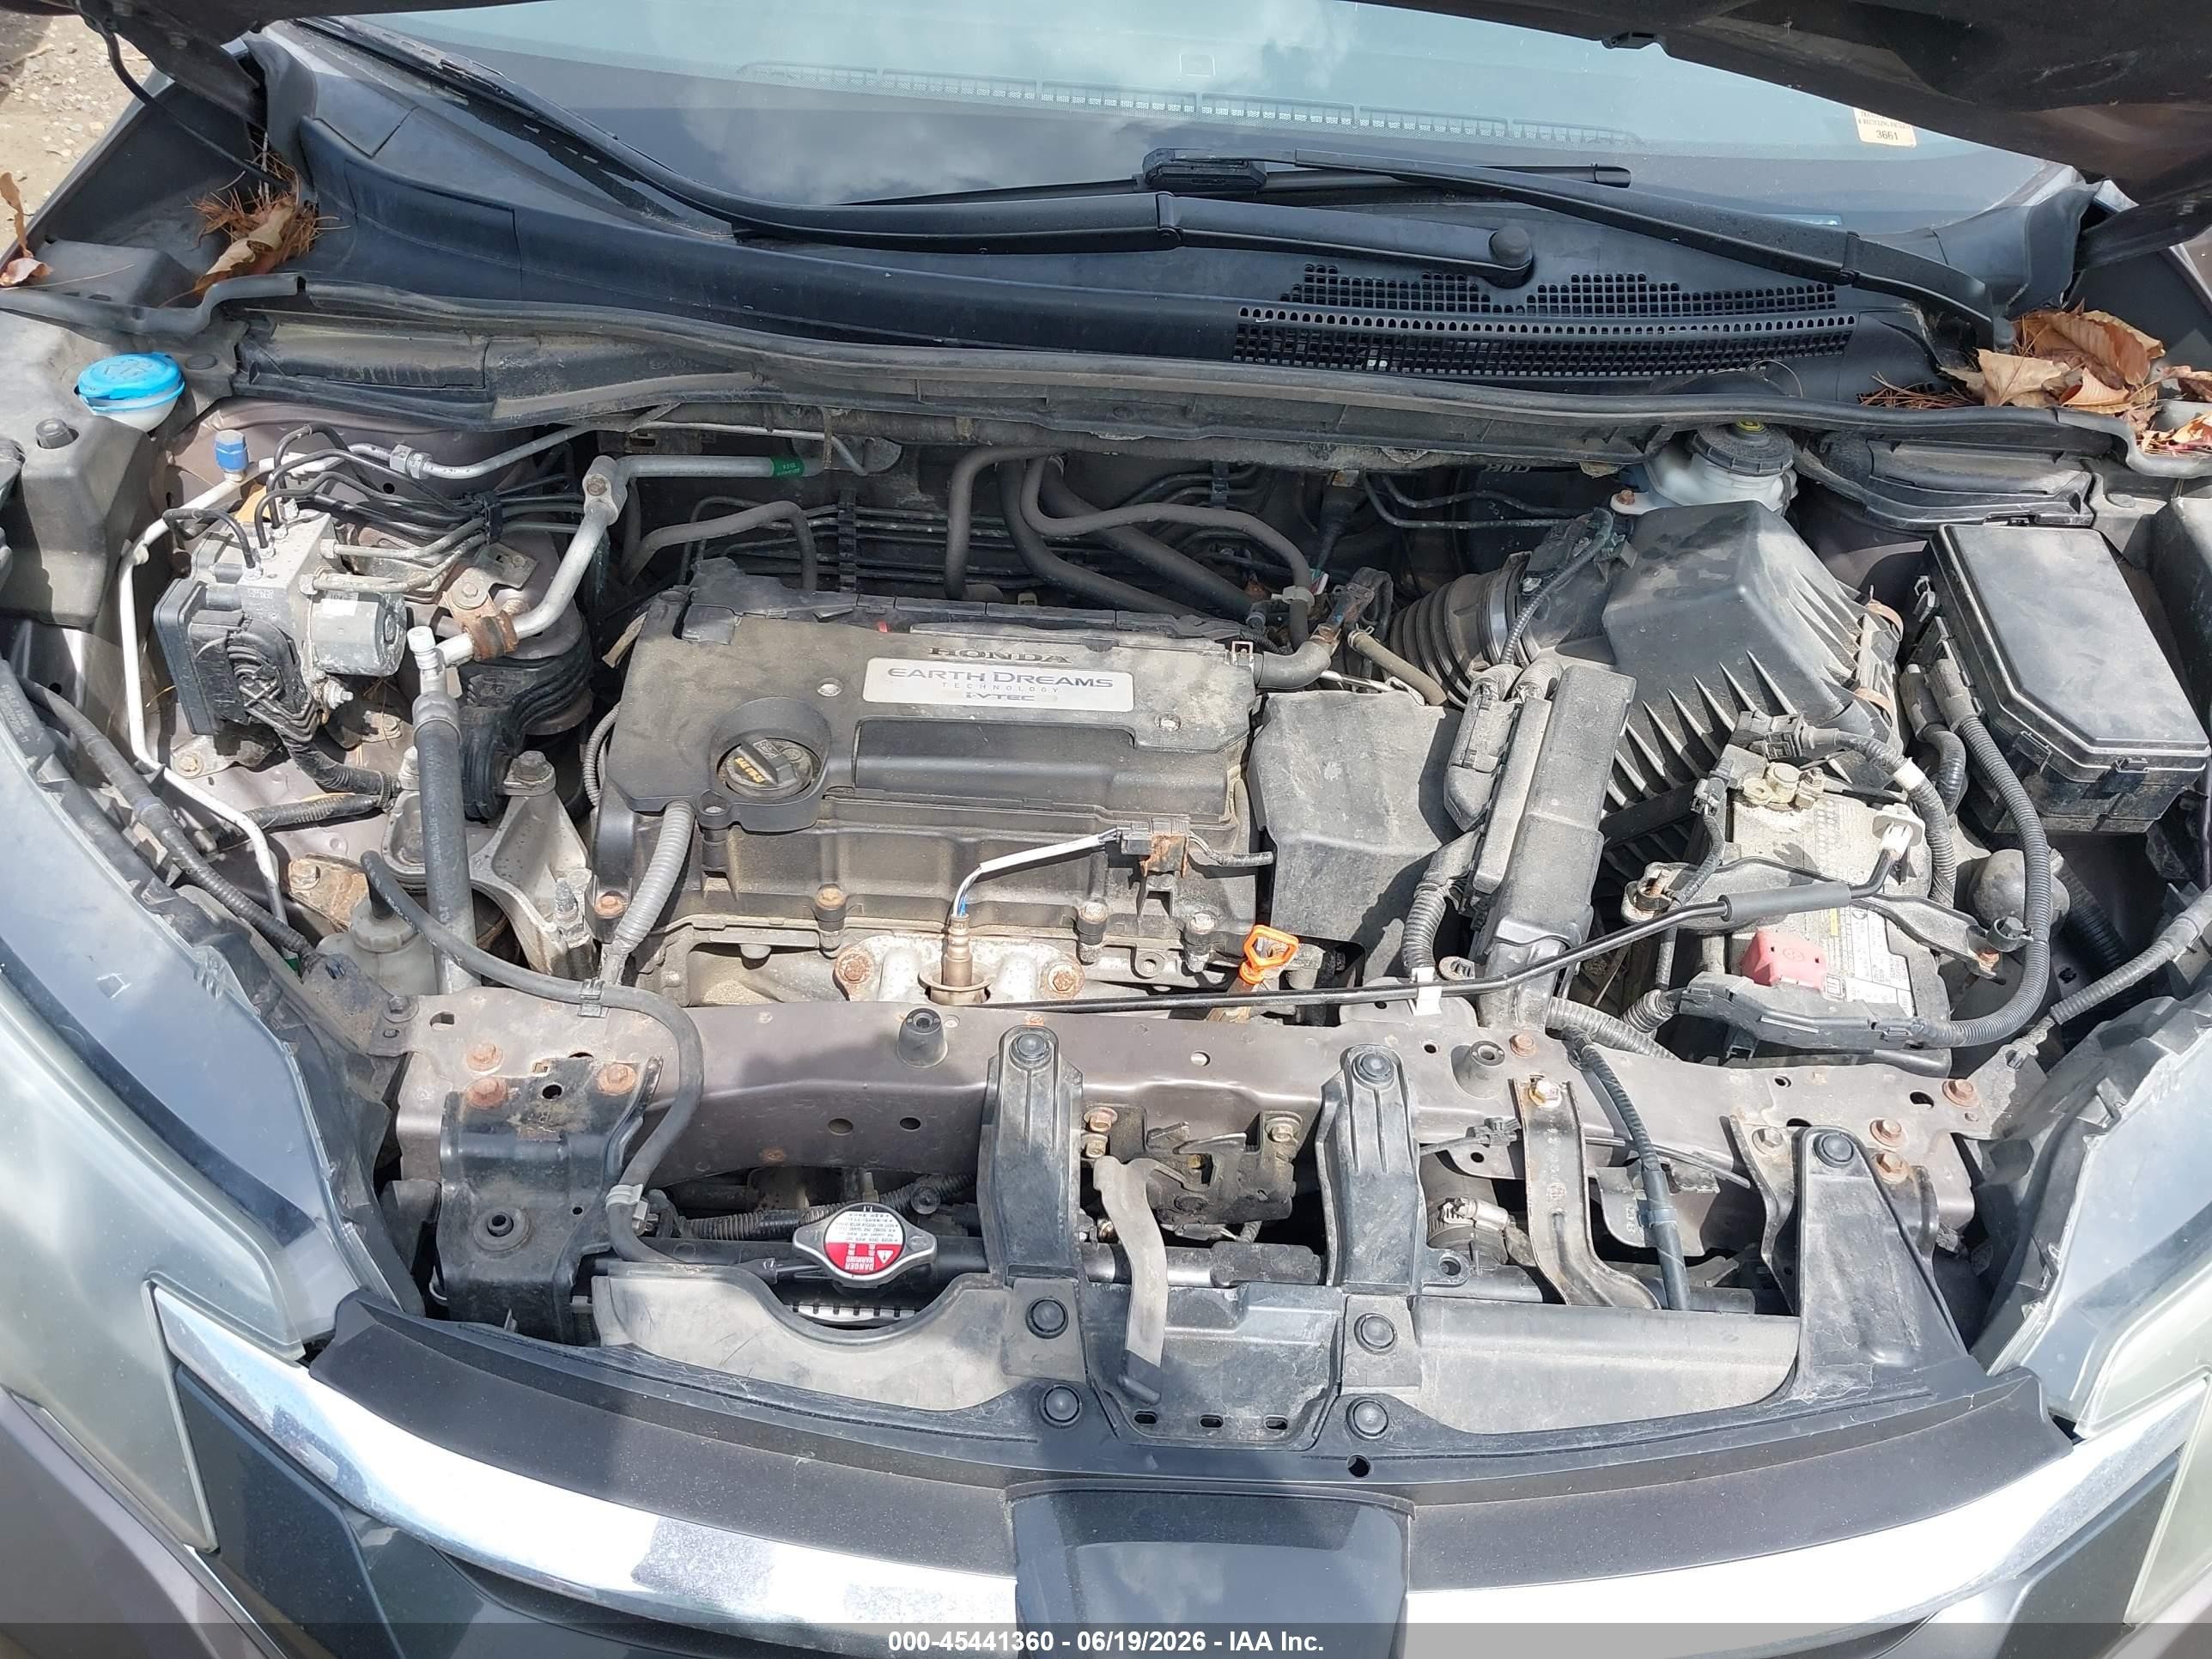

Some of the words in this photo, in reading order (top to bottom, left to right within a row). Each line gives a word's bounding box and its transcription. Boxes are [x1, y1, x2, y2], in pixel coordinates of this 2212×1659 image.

[928, 647, 1072, 664] HONDA
[887, 667, 986, 681] EARTH
[994, 672, 1114, 688] DREAMS
[942, 682, 1059, 693] TECHNOLOGY
[845, 1262, 874, 1271] DANGER
